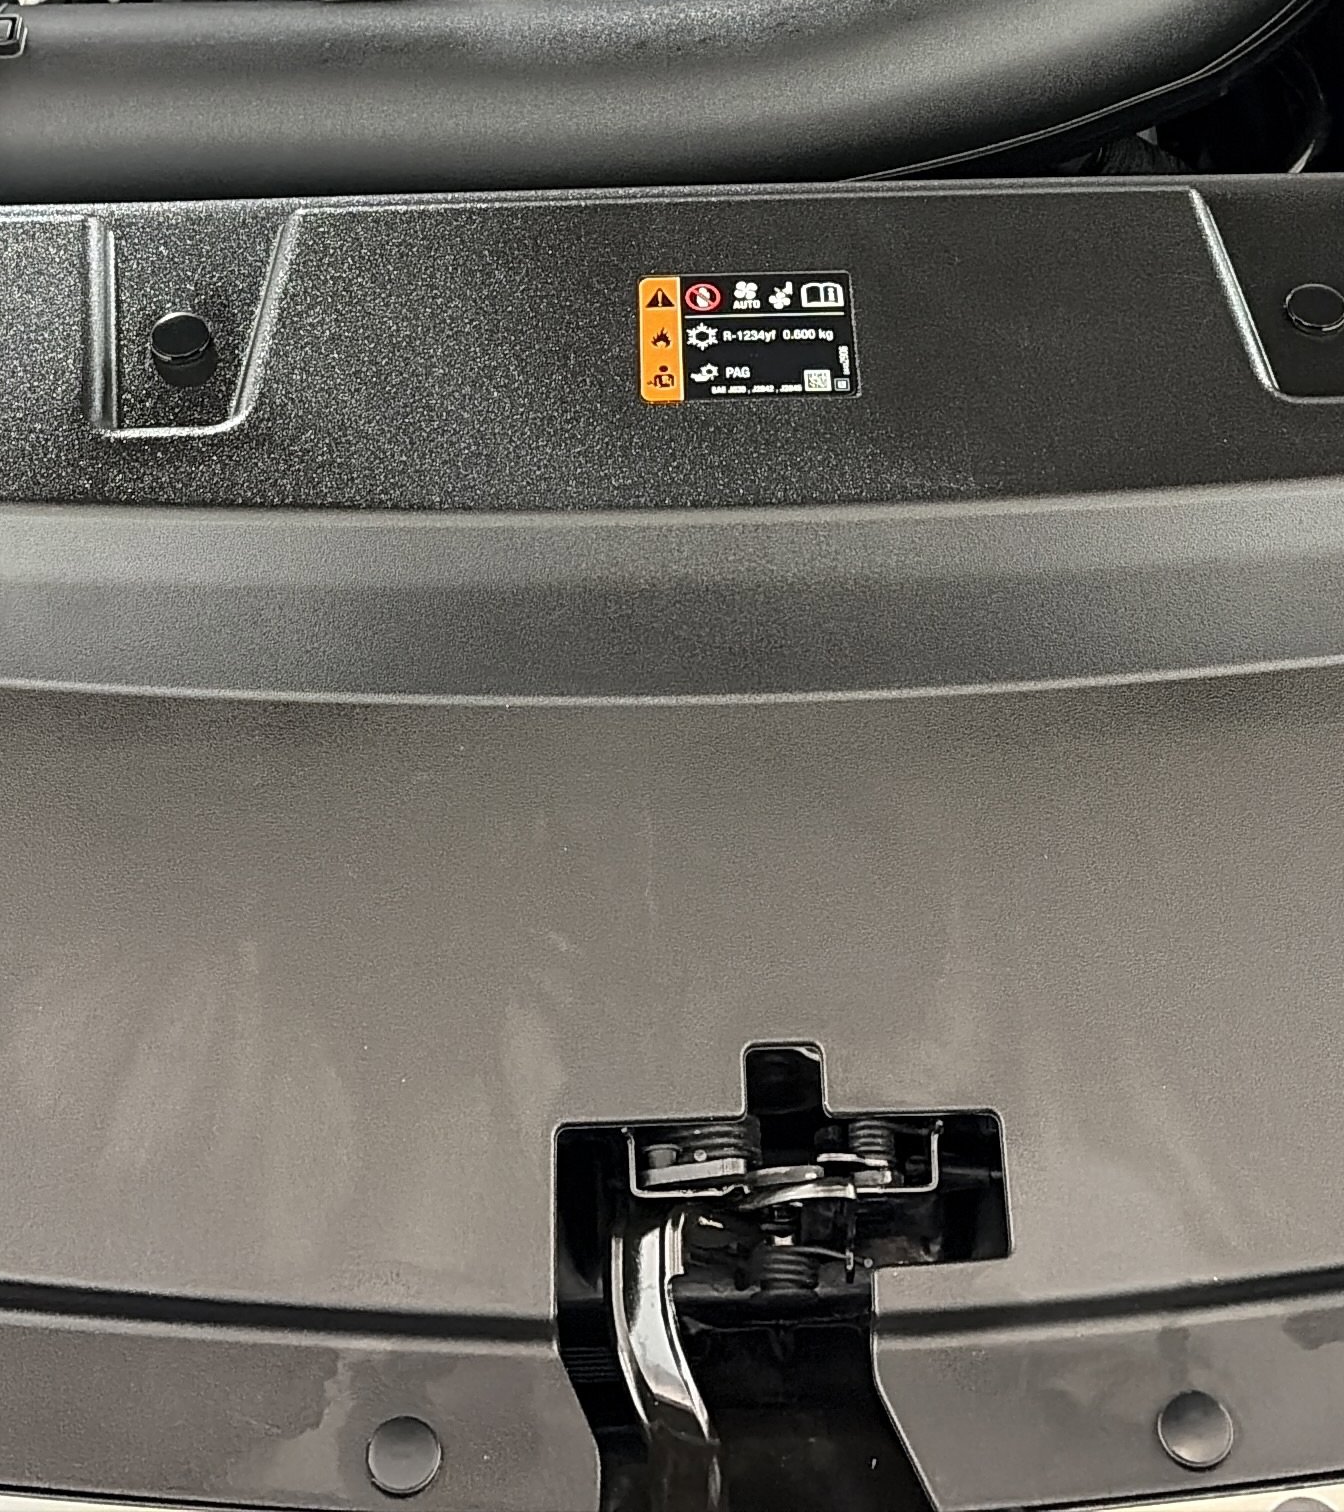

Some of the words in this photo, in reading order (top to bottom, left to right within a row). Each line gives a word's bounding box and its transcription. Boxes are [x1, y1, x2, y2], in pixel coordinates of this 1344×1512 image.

[732, 299, 761, 310] AUTO
[722, 329, 776, 343] R-1234yf
[818, 328, 834, 341] kg
[725, 366, 751, 379] PAG
